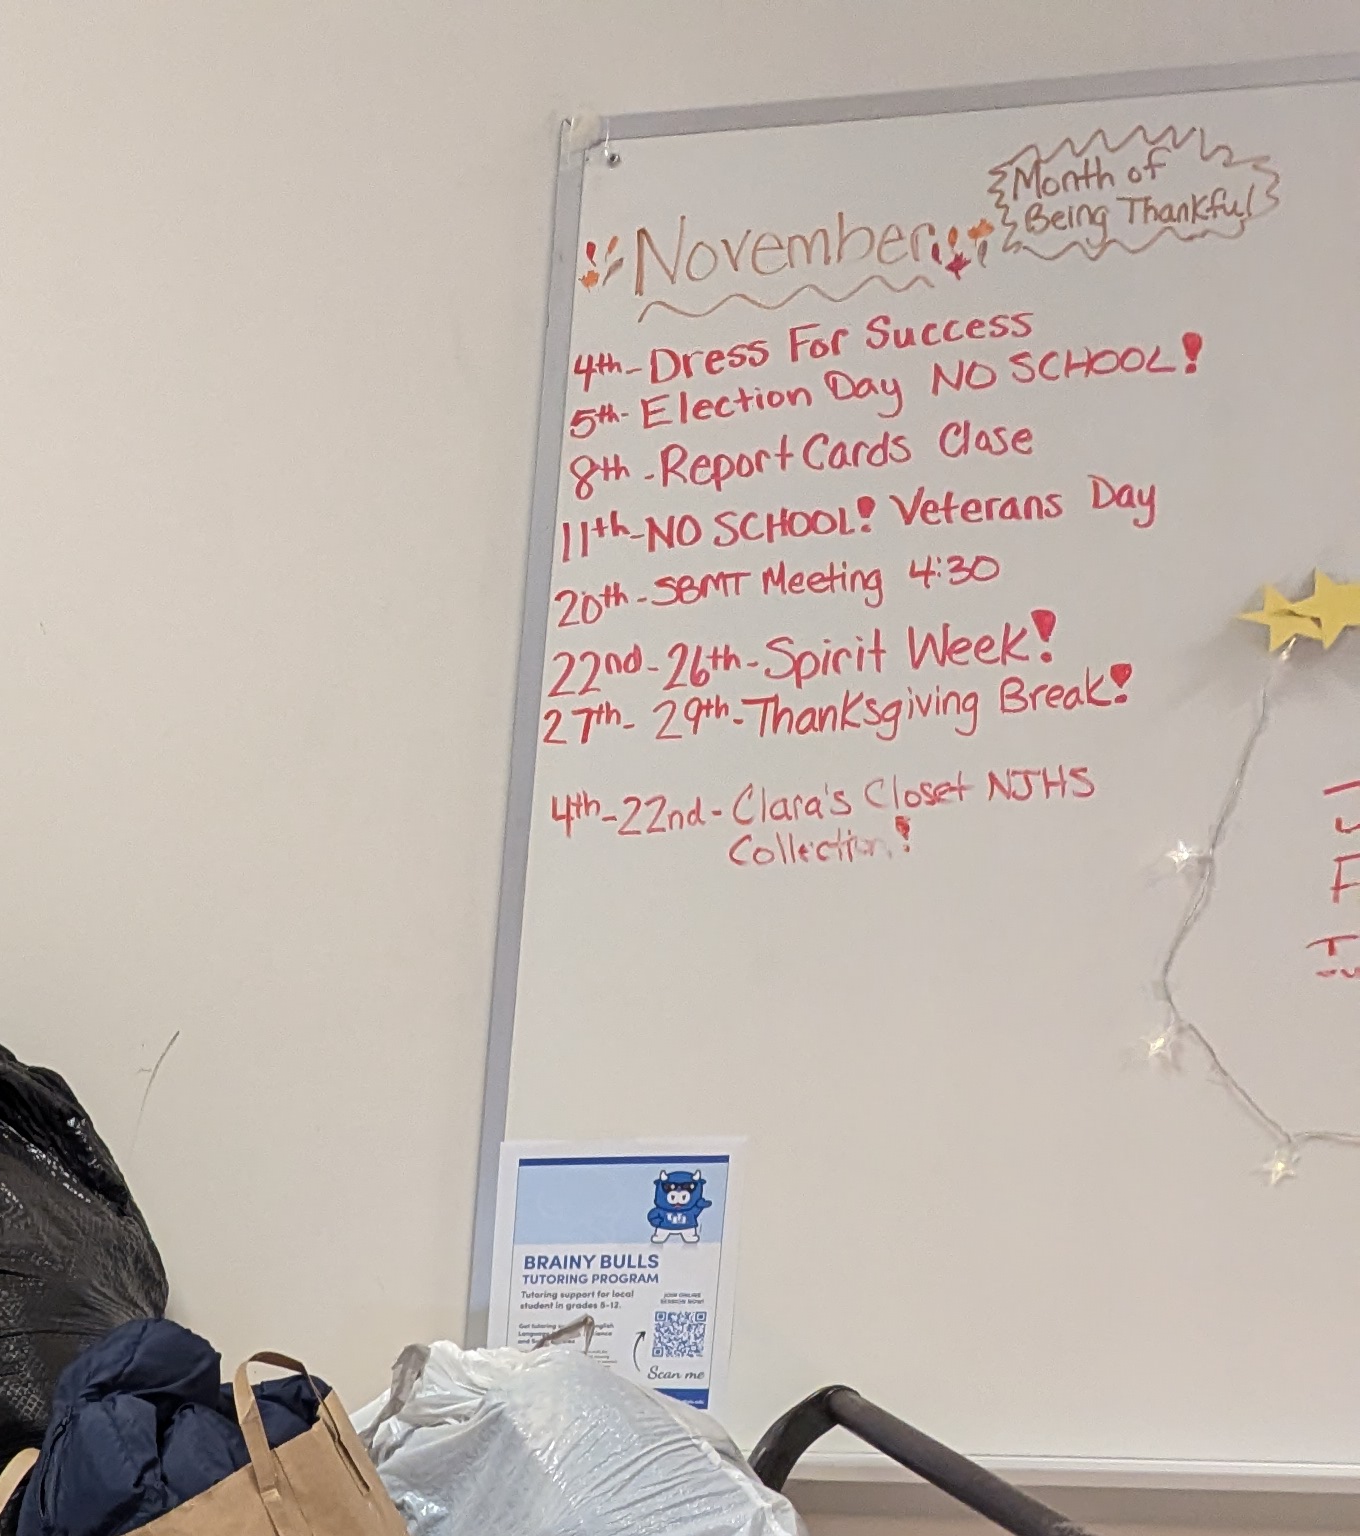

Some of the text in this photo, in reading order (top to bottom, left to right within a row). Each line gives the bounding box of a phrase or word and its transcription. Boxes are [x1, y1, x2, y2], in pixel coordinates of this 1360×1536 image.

[1012, 146, 1172, 201] Month of
[1024, 183, 1256, 249] Being Thankful
[634, 210, 942, 296] November
[789, 322, 849, 362] For
[866, 312, 1034, 350] Success
[640, 386, 812, 429] Election
[823, 370, 904, 418] Day
[931, 359, 997, 397] NO
[1008, 331, 1203, 384] SCHOOL!
[802, 431, 912, 471] Cards
[889, 486, 1063, 525] Veterans
[1088, 474, 1156, 529] Day
[762, 561, 884, 609] Meeting
[909, 555, 1000, 589] 4:30
[908, 609, 1057, 671] Week!
[1000, 663, 1133, 714] Break!
[732, 783, 853, 826] Clara's
[864, 771, 974, 811] Closet
[987, 766, 1095, 801] NJHS
[522, 1273, 659, 1285] TUTORING PROGRAM
[523, 1254, 659, 1270] BRAINY BULLS
[520, 1302, 553, 1310] student
[555, 1301, 564, 1309] in
[566, 1302, 597, 1311] grades
[521, 1289, 635, 1301] Tutoring support for local
[648, 1365, 705, 1380] Scan me
